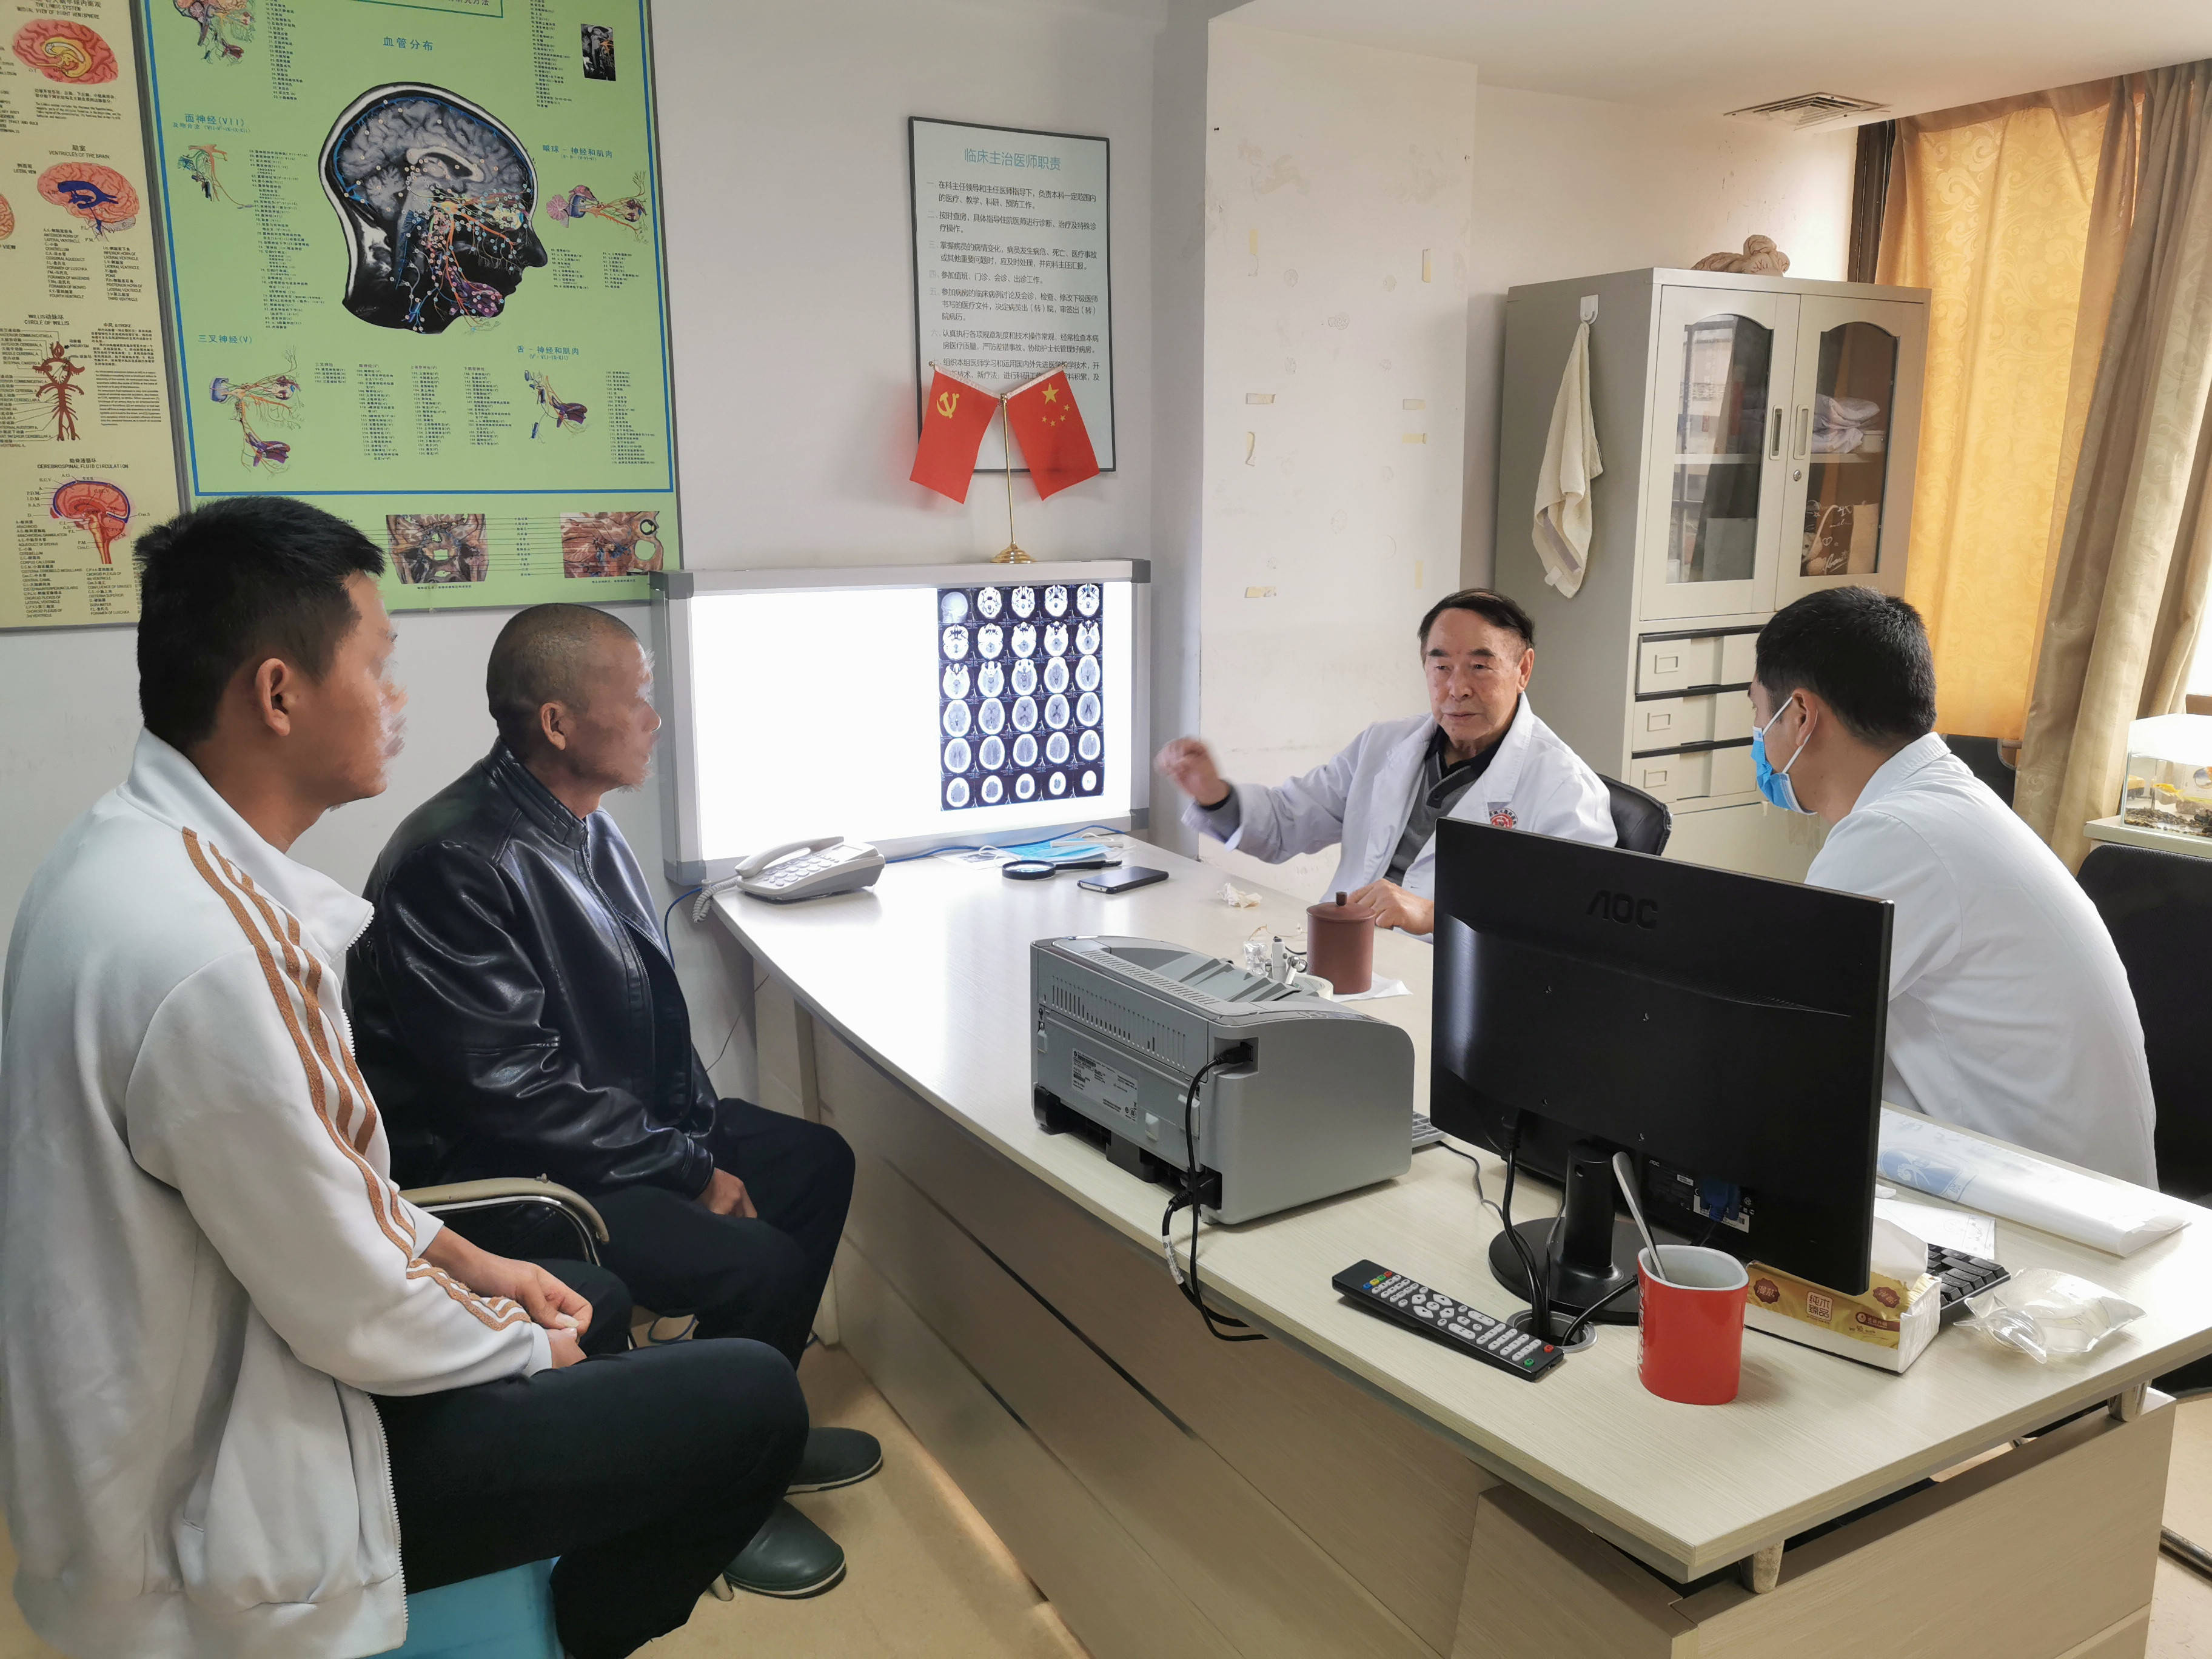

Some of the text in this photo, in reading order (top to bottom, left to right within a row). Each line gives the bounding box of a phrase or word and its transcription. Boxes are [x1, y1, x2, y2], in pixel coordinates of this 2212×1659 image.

[383, 36, 433, 51] 血管分布
[571, 147, 612, 158] 神经和肌肉
[964, 148, 1061, 171] 临床主治医师职责
[939, 224, 964, 233] 疗操作。
[942, 312, 966, 321] 院病历。
[198, 335, 252, 344] 三叉神经(V)
[537, 346, 579, 355] 神经和肌肉
[1586, 890, 1660, 931] AOC
[1809, 1294, 1830, 1309] 纯木
